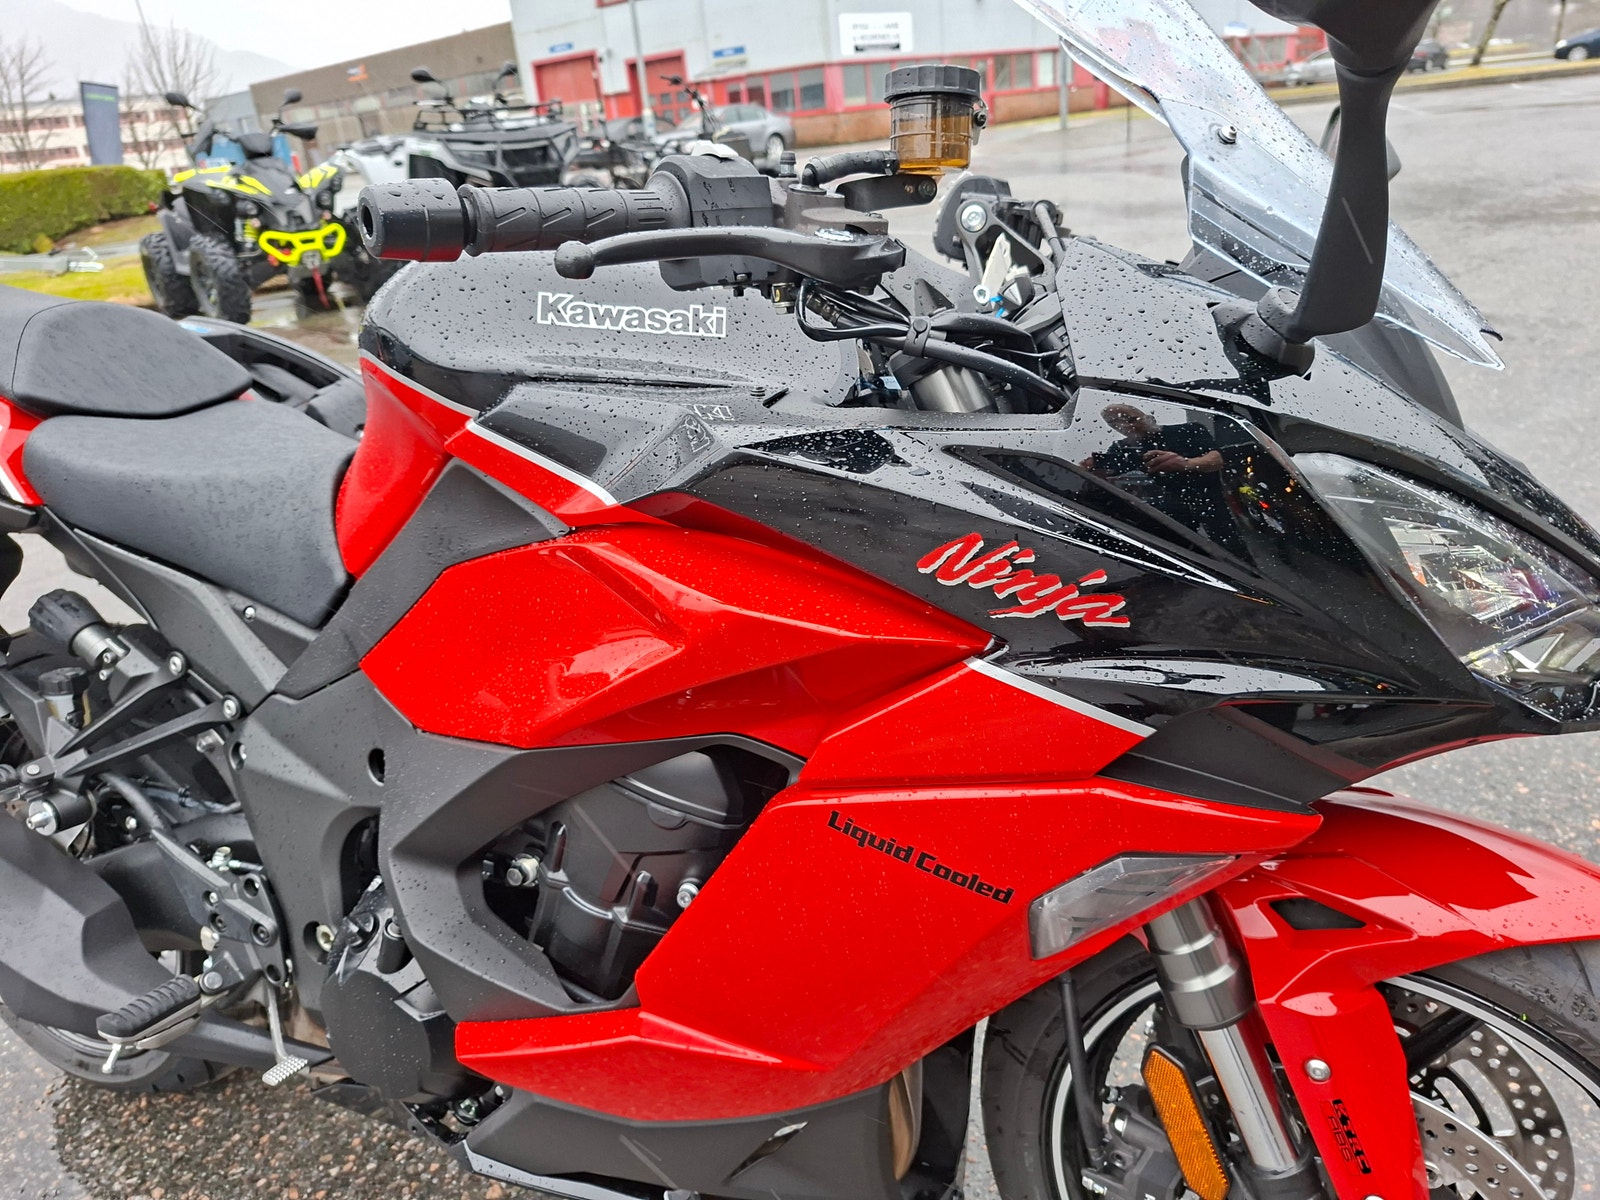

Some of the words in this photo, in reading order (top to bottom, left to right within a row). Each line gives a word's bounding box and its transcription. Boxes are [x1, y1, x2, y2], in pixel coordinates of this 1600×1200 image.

[537, 291, 727, 338] Kawasaki
[916, 532, 1131, 628] Ninja
[827, 810, 915, 865] Liquid
[914, 851, 1015, 905] Cooled
[1328, 1115, 1352, 1162] ABS
